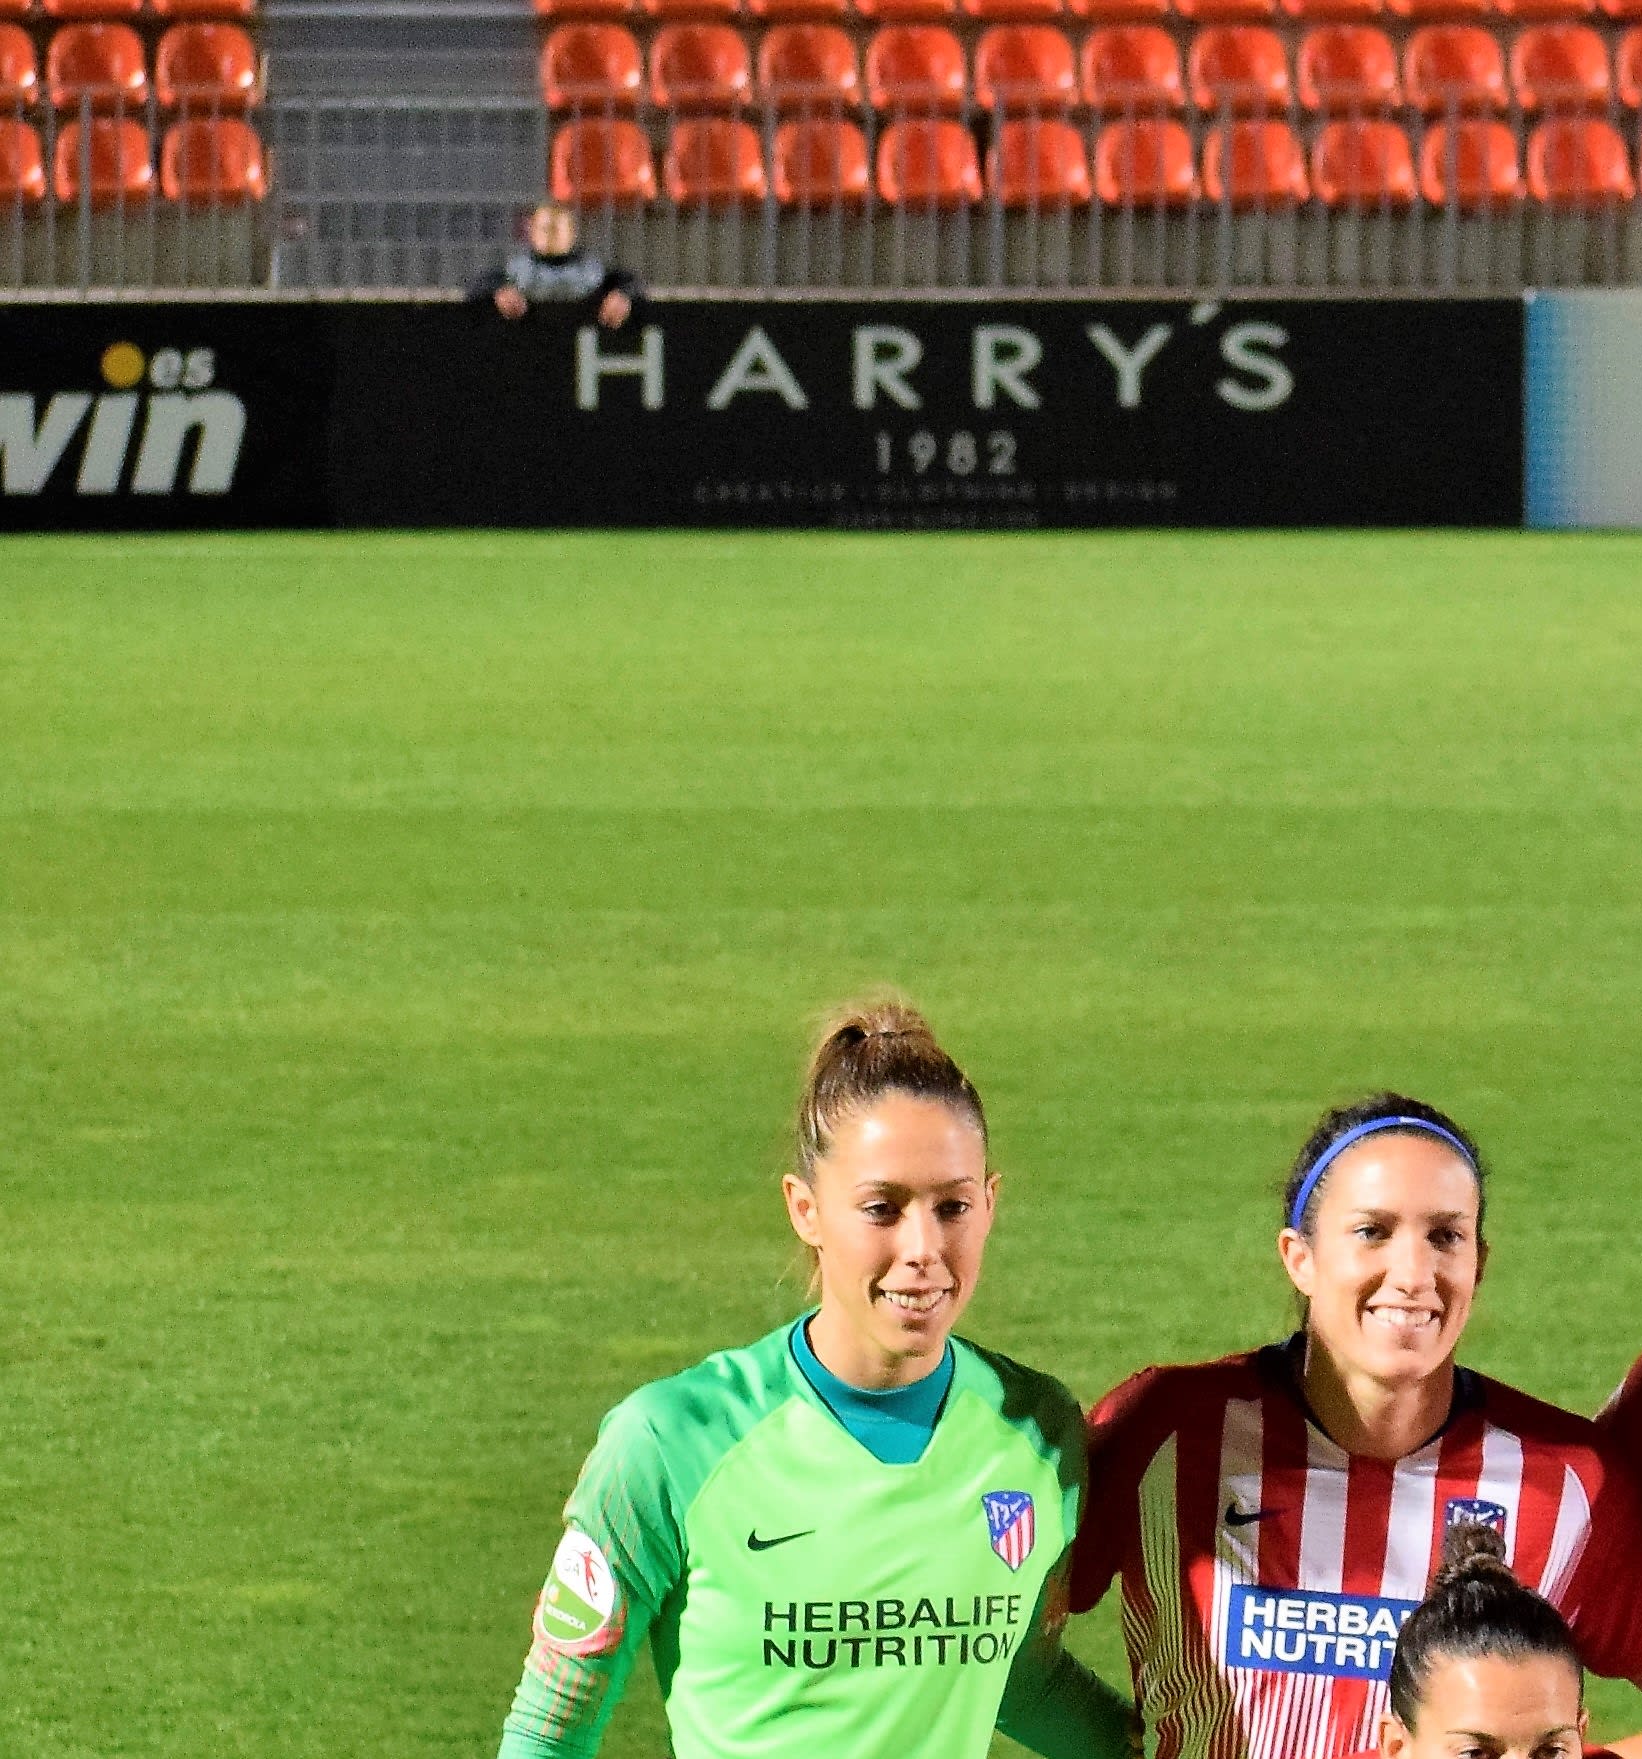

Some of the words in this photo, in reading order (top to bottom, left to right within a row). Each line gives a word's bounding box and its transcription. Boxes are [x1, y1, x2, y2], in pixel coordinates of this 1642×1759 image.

[575, 301, 1295, 411] HARRY'S
[875, 429, 1017, 476] 1982
[763, 1594, 1022, 1633] HERBALIFE
[1242, 1595, 1412, 1639] HERBA
[763, 1631, 1016, 1670] NUTRITION
